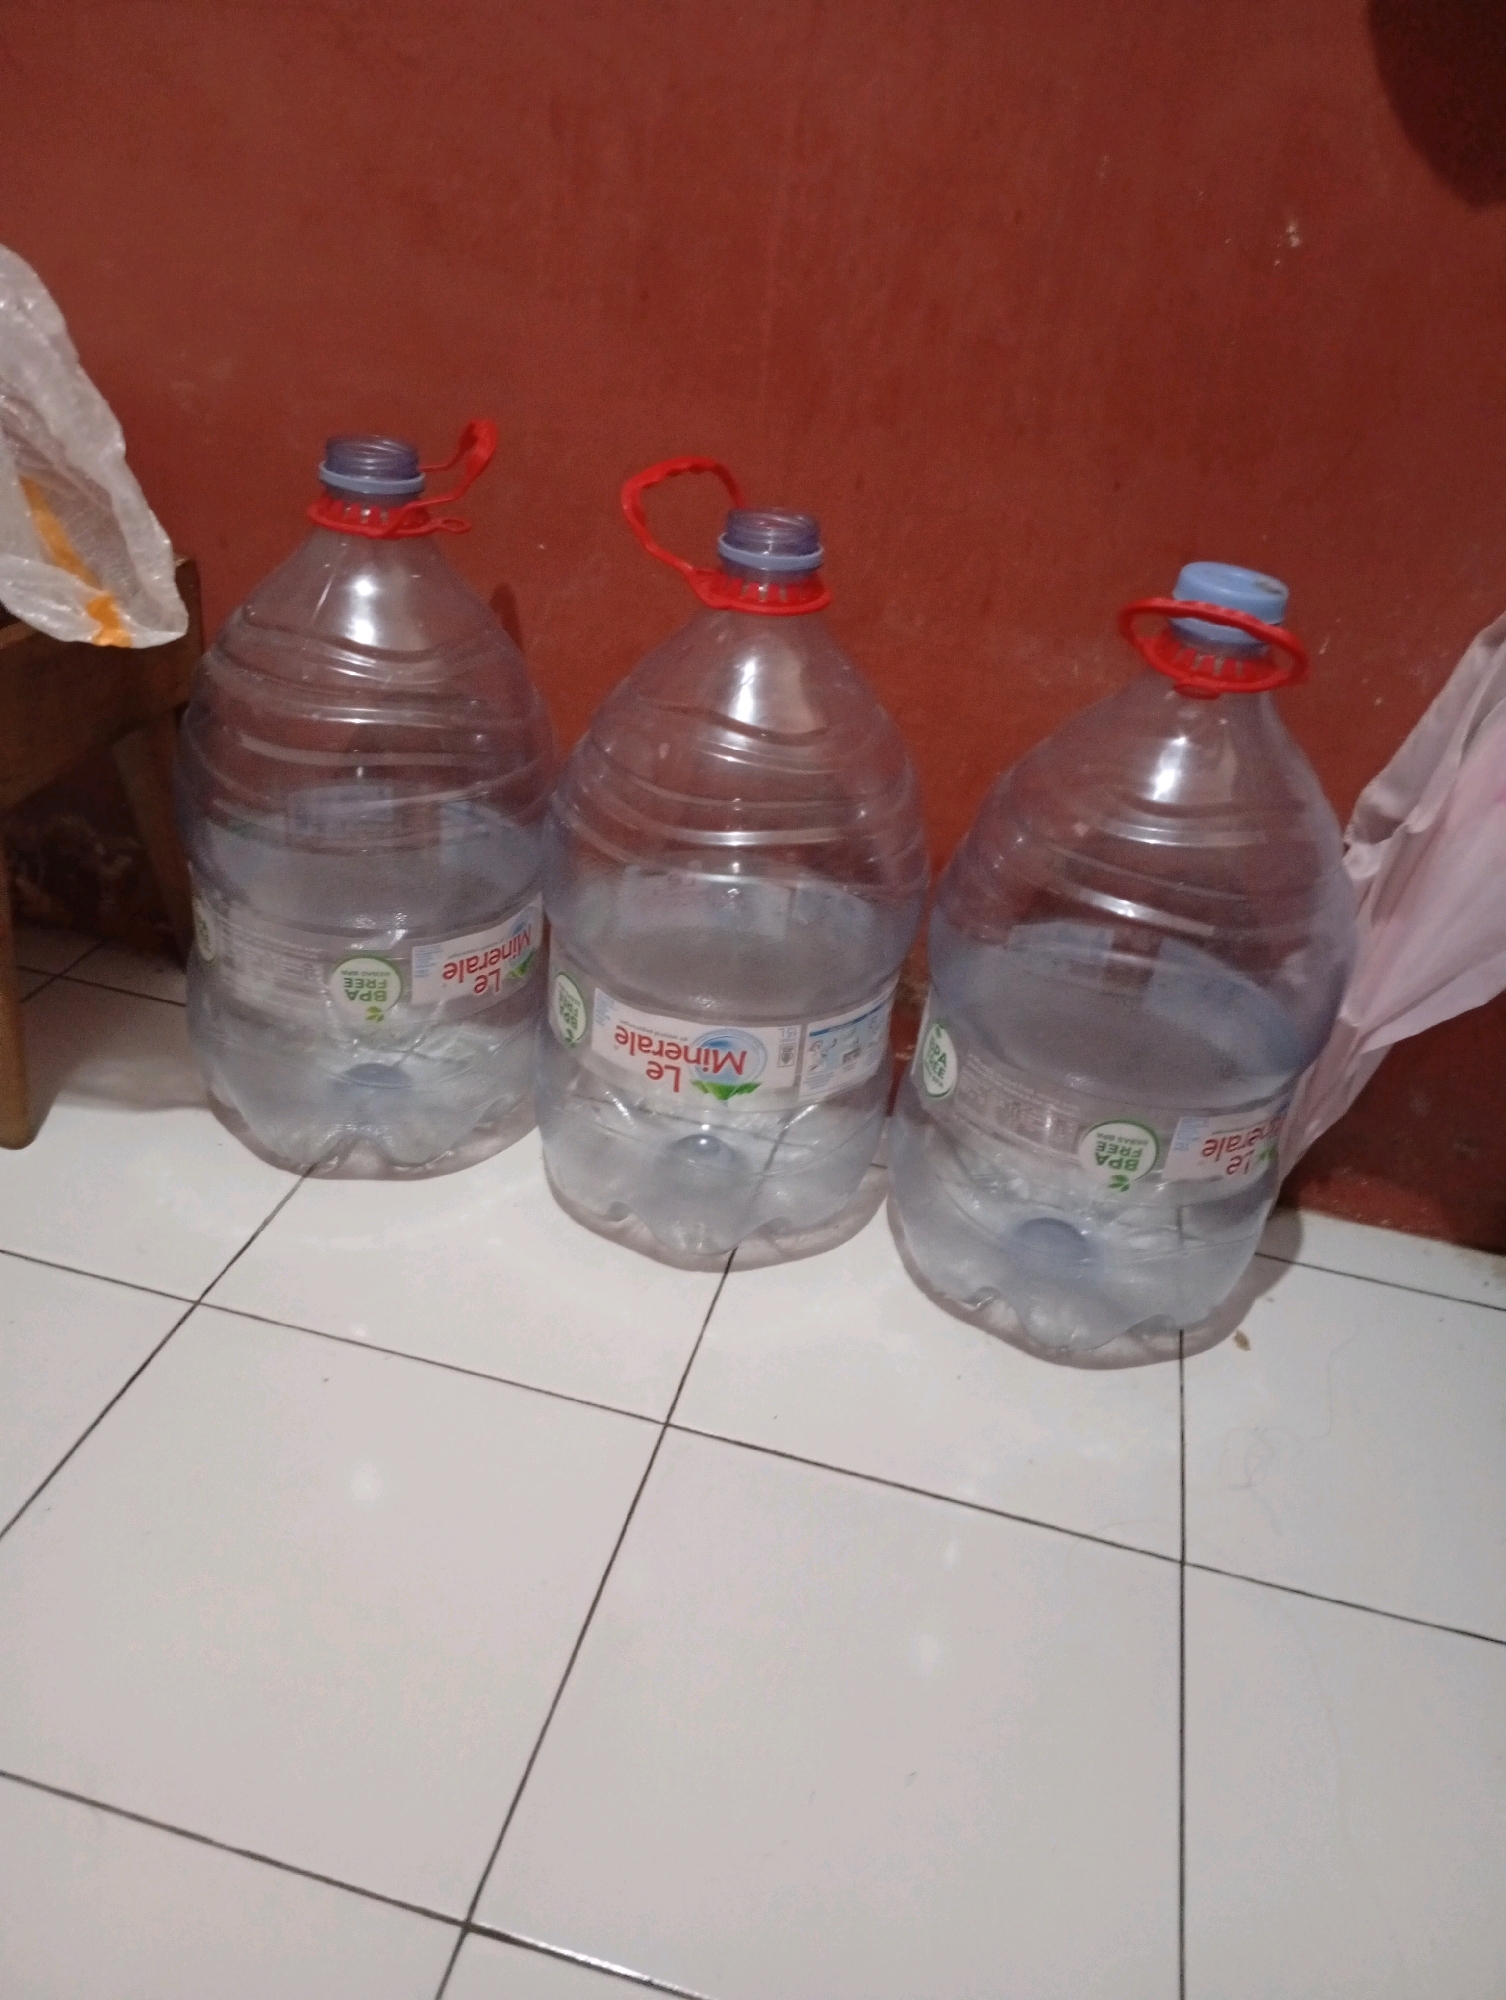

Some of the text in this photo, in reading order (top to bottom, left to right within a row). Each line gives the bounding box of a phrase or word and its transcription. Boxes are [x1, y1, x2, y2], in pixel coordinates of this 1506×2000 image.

[442, 923, 532, 983] Minerale
[343, 977, 387, 989] FREE
[344, 988, 388, 1001] BPA
[474, 967, 501, 995] Le
[615, 1025, 748, 1076] Minerale
[646, 1060, 681, 1093] Le
[1095, 1152, 1139, 1172] BPA
[1096, 1141, 1143, 1158] FREE
[1227, 1148, 1256, 1176] Le
